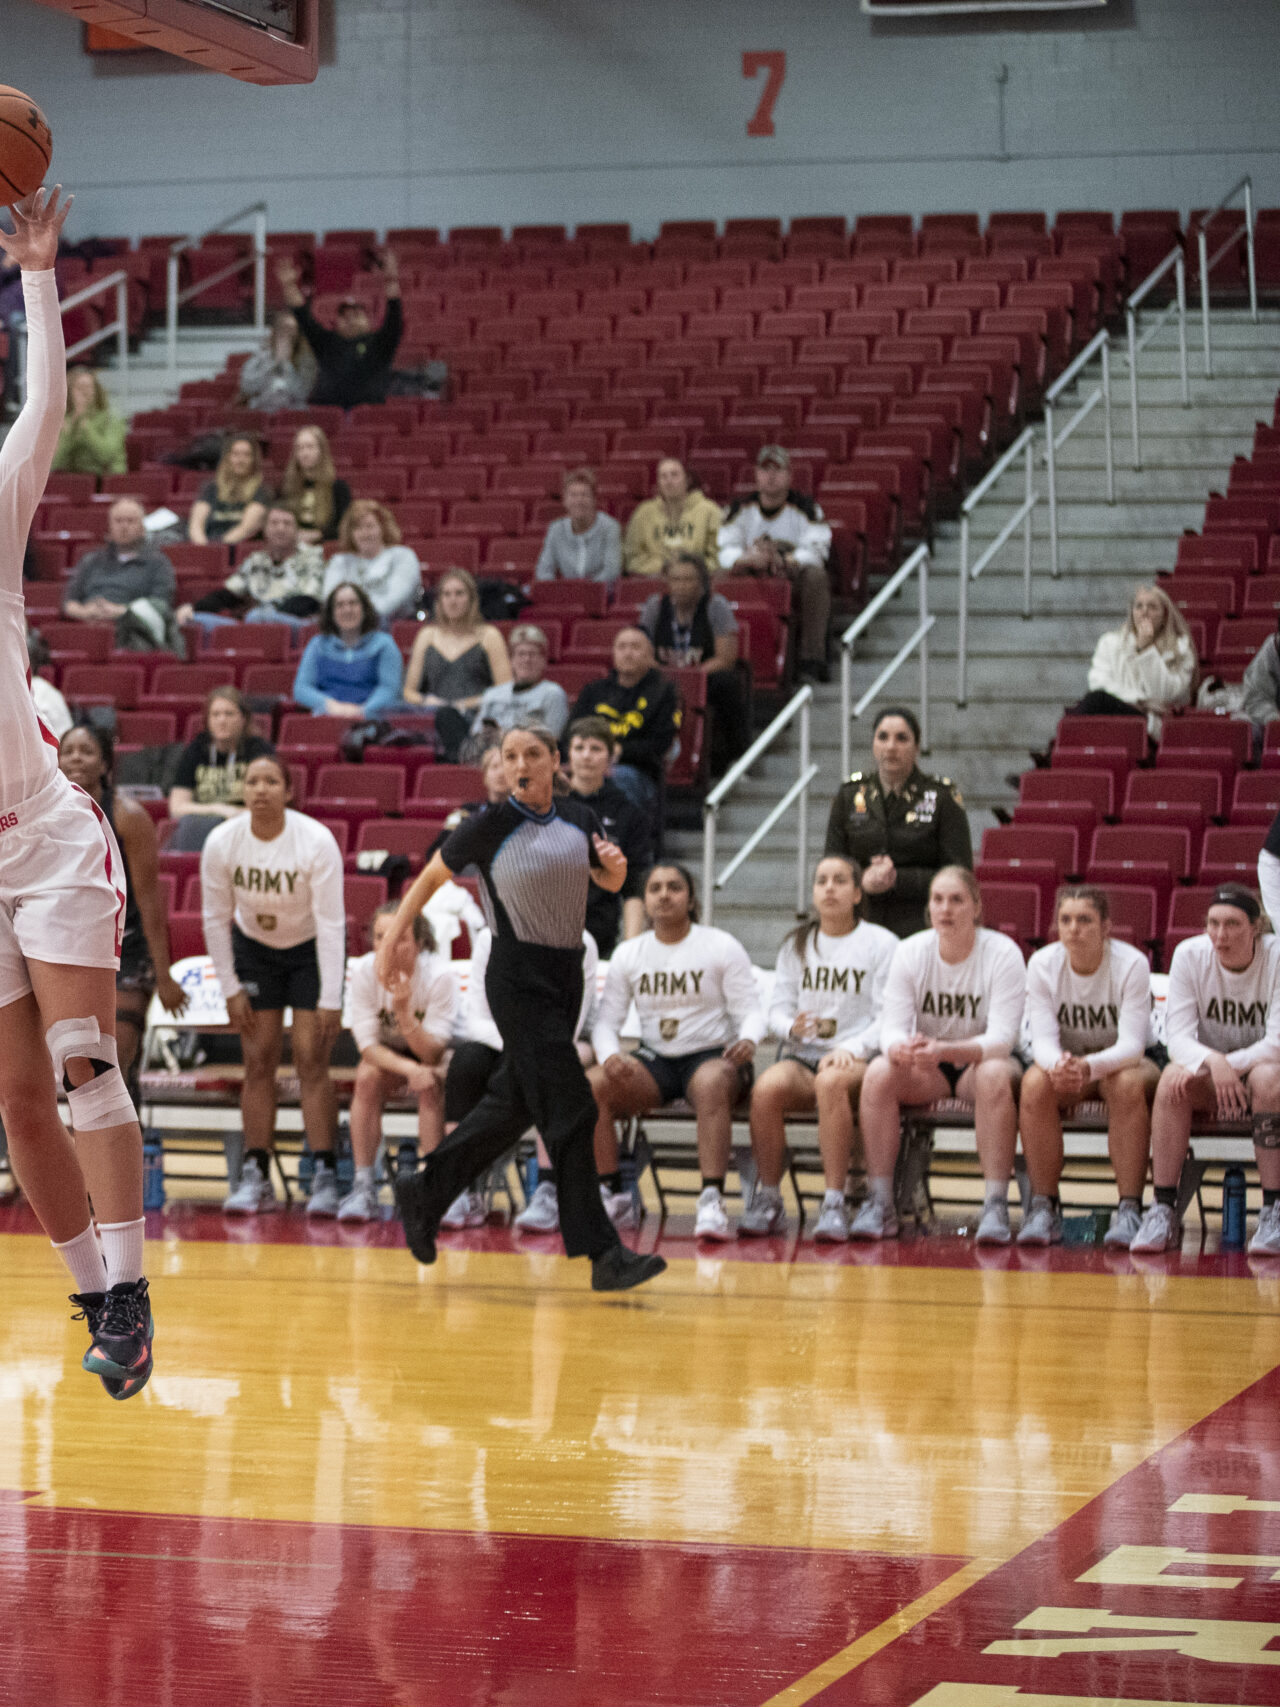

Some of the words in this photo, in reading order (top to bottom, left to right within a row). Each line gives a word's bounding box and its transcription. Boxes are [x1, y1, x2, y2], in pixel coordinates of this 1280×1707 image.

[742, 49, 786, 136] 7
[233, 866, 298, 893] ARMY
[640, 970, 704, 995] ARMY
[802, 966, 866, 994] ARMY
[922, 991, 982, 1019] ARMY
[1057, 1002, 1119, 1029] ARMY
[1207, 997, 1268, 1027] ARMY
